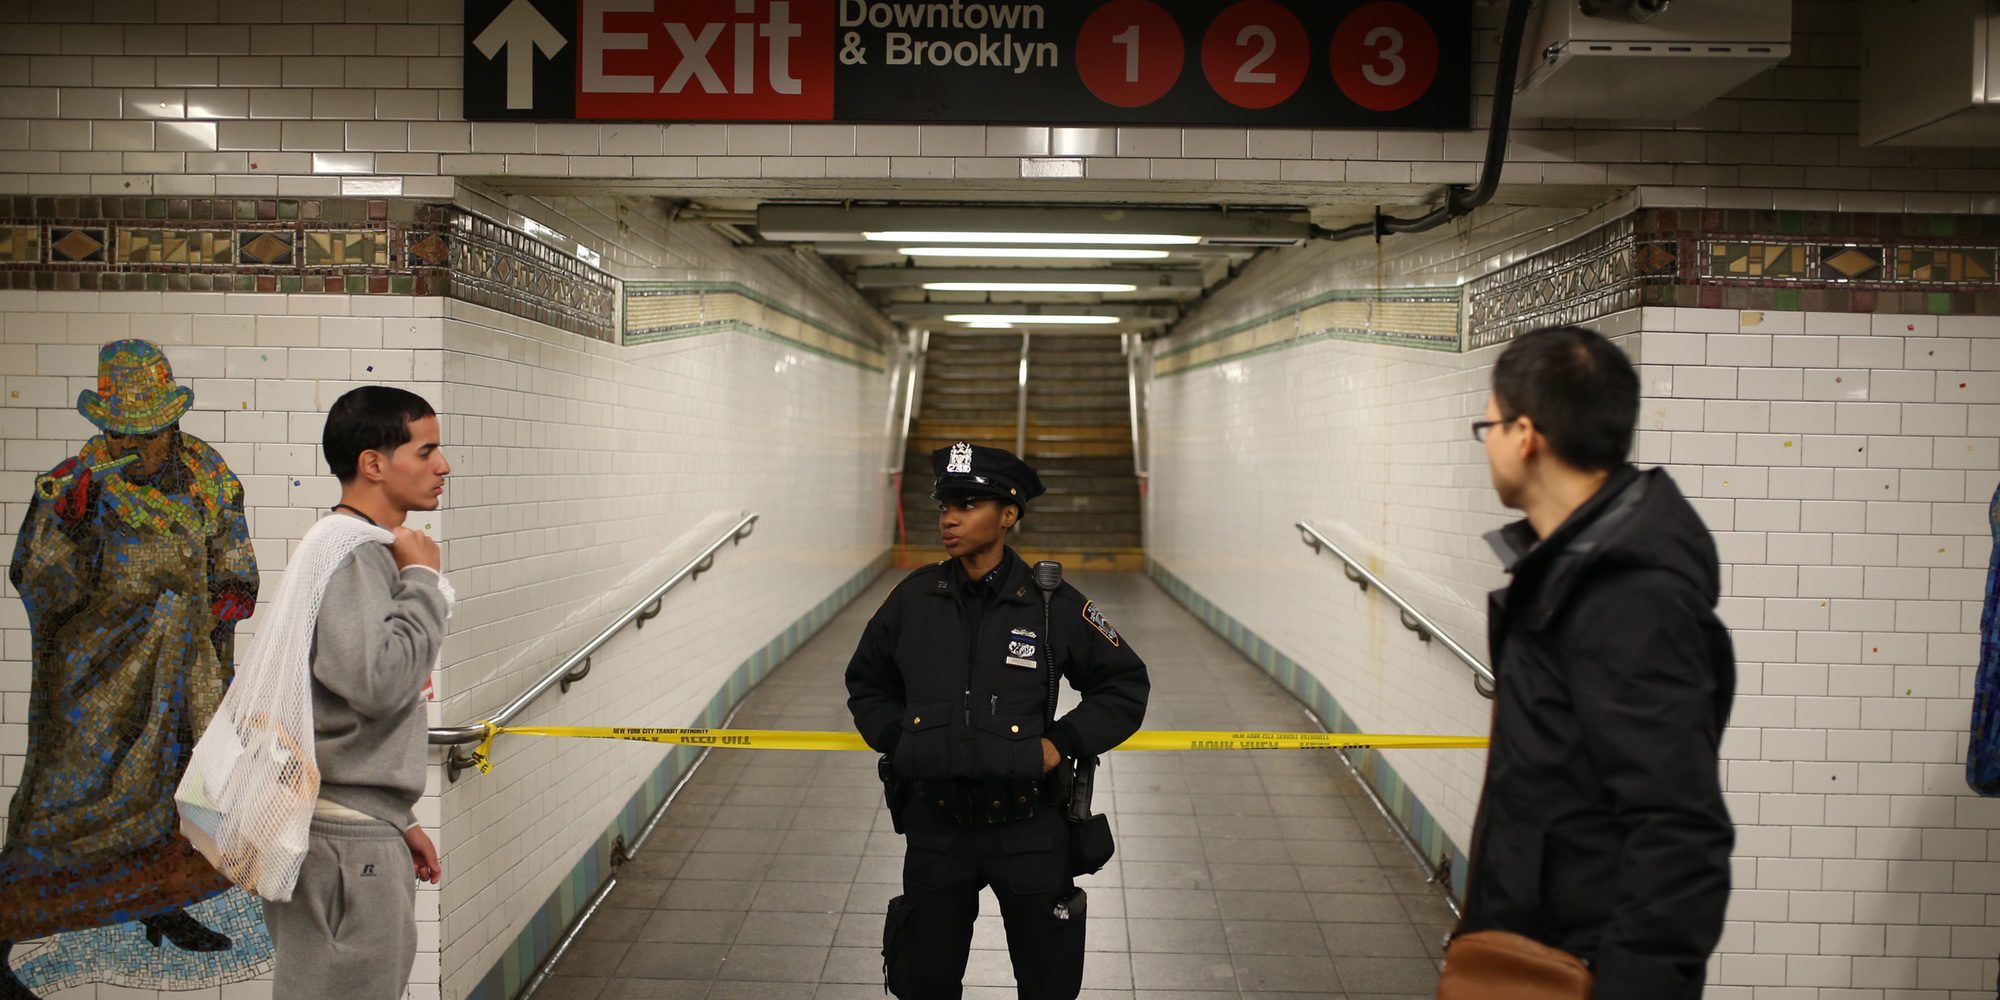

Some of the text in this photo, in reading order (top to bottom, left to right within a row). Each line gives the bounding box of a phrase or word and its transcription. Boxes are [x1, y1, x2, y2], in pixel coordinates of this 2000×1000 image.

[839, 0, 1044, 28] Downtown
[582, 0, 802, 95] Exit
[839, 32, 1058, 74] & Brooklyn
[1112, 24, 1407, 86] 1 2 3
